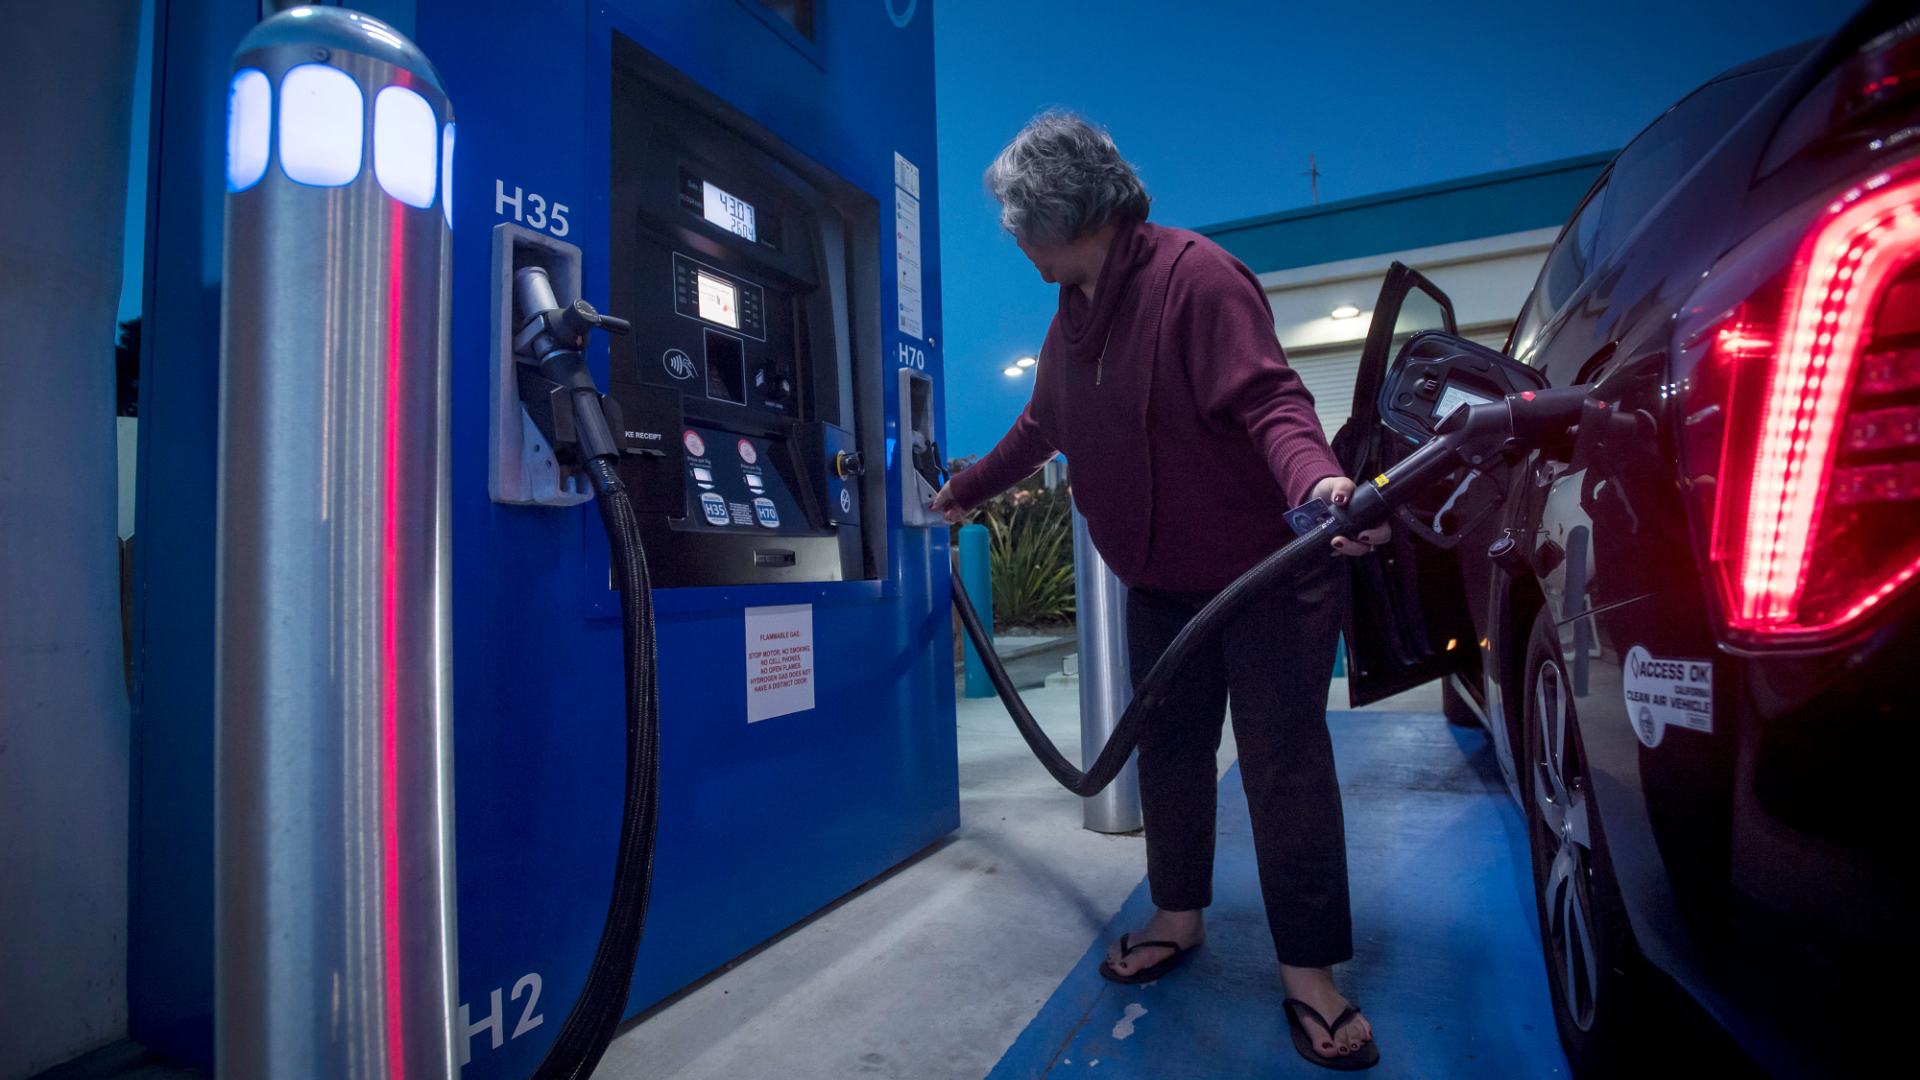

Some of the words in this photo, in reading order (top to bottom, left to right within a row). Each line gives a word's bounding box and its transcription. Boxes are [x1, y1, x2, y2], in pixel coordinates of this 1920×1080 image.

[496, 179, 569, 237] H35
[899, 342, 925, 370] H70
[625, 430, 634, 438] KE
[635, 432, 662, 440] RECEIPT
[705, 503, 726, 516] H35
[758, 506, 776, 519] H70
[1640, 661, 1684, 681] ACCESS
[1690, 664, 1711, 683] OK
[1626, 690, 1650, 704] CLEAN
[1653, 694, 1667, 706] AIR
[1670, 697, 1711, 714] VEHICLE
[458, 972, 544, 1068] H2
